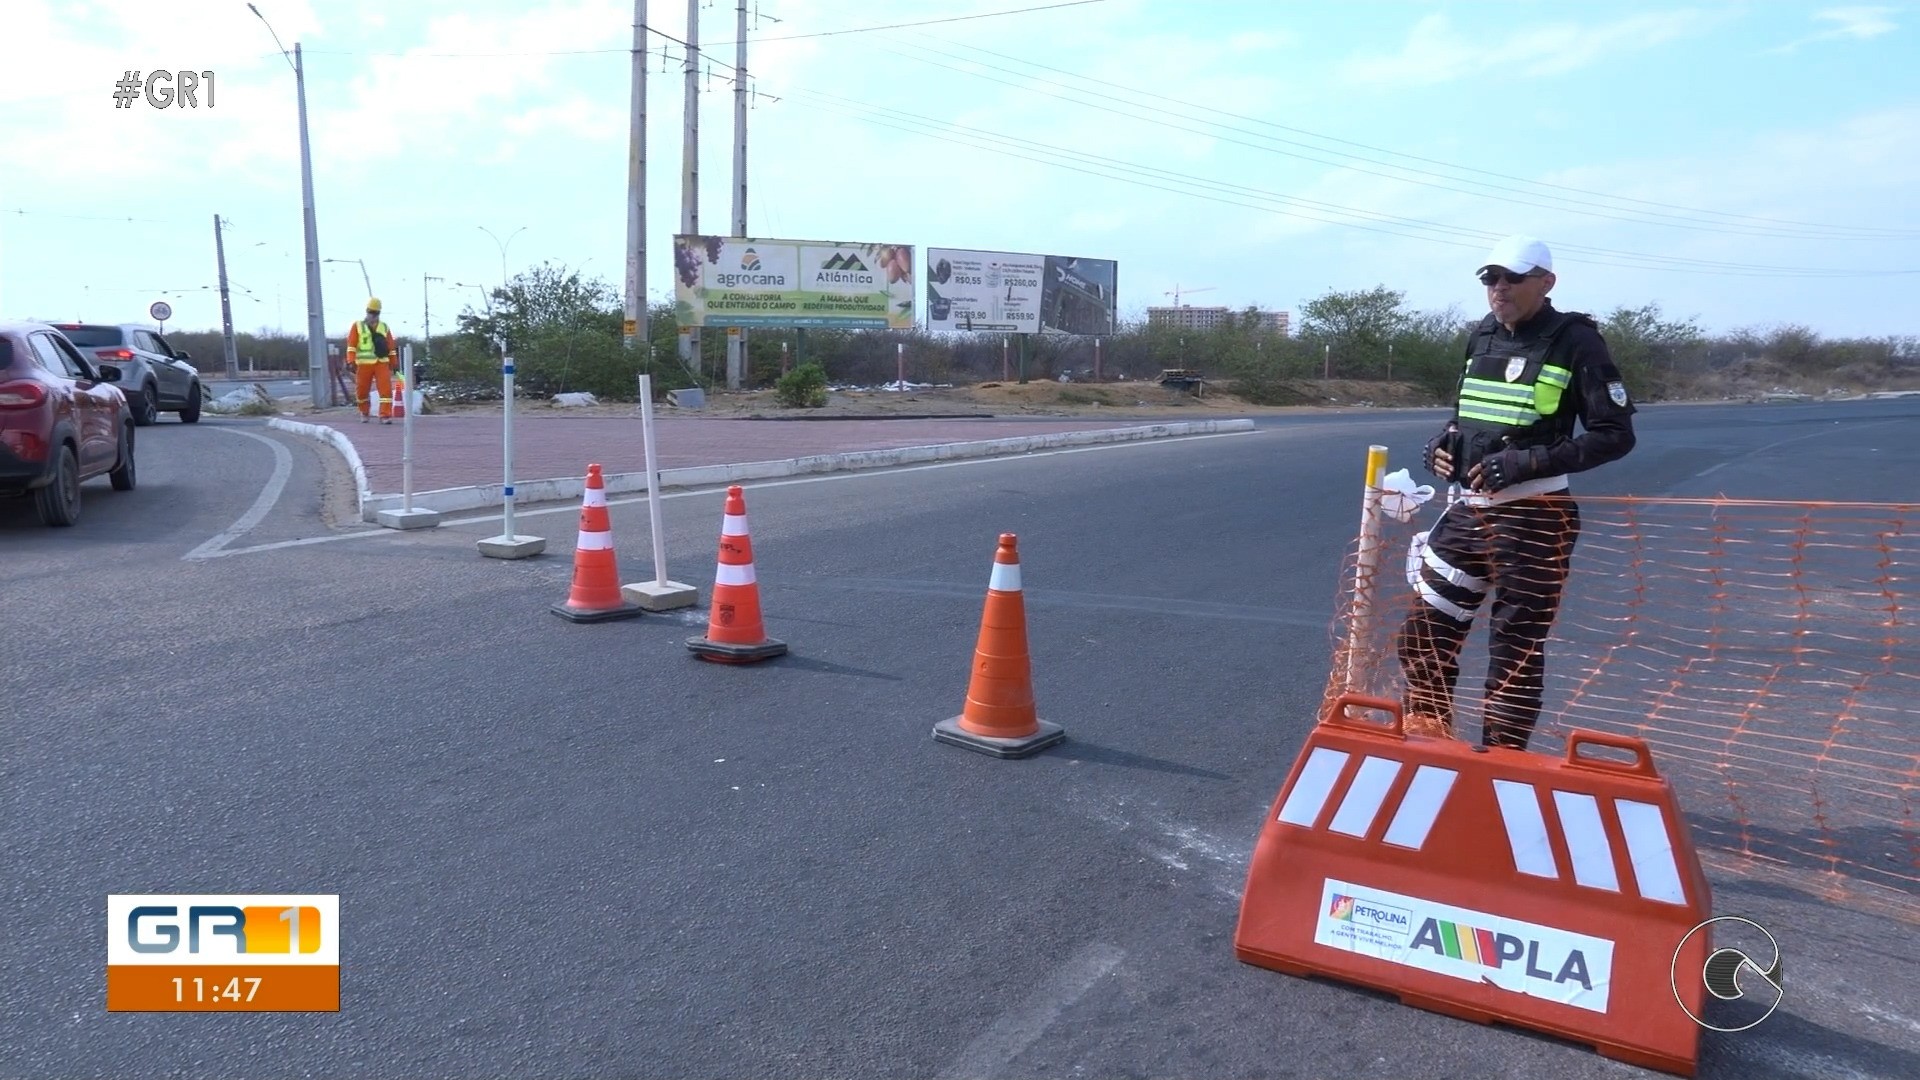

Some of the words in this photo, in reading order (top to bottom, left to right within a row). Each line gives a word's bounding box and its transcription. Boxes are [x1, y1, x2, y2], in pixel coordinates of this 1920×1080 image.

[717, 273, 785, 287] agrocana
[816, 271, 873, 284] Atlántica
[955, 276, 982, 285] R$0,55
[722, 293, 729, 301] A
[729, 293, 782, 301] CONSULTORIA
[827, 295, 852, 303] MARCA
[853, 296, 869, 304] QUE
[707, 301, 725, 309] QUE
[725, 301, 760, 309] ENTENDE
[1355, 905, 1407, 925] PETROLINA
[1341, 924, 1355, 932] COM
[1336, 931, 1357, 939] GENTE
[1359, 935, 1374, 943] VIVE
[1375, 940, 1402, 949] MELHOR
